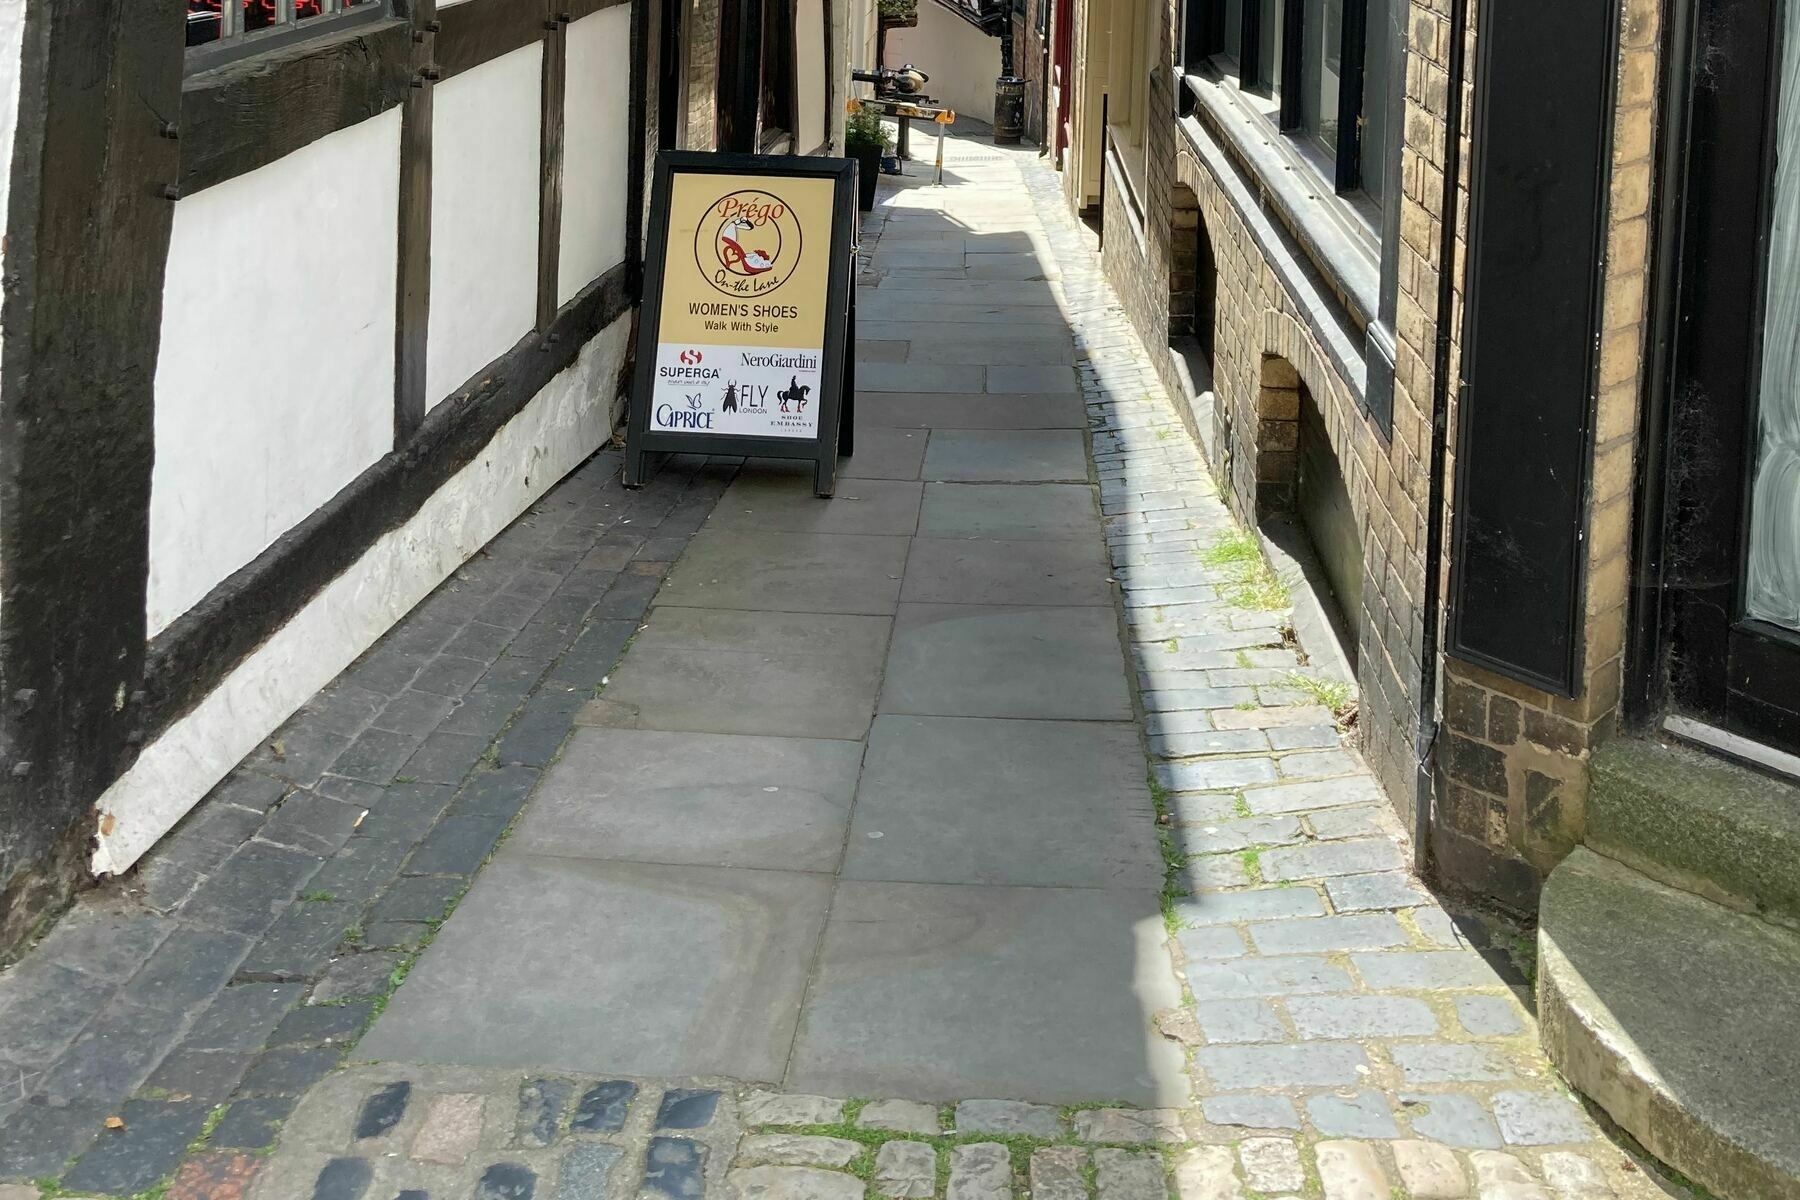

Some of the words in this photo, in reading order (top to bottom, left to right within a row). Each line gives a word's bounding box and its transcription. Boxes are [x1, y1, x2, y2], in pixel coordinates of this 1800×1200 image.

[717, 197, 785, 227] Prégo
[753, 276, 780, 292] Lane
[689, 302, 749, 317] WOMEN'S
[753, 305, 798, 319] SHOES
[704, 320, 727, 331] Walk
[731, 321, 752, 332] With
[755, 322, 779, 334] Style
[741, 352, 817, 369] NeroGiardini
[659, 366, 720, 379] SUPERGA
[740, 384, 769, 407] FLY
